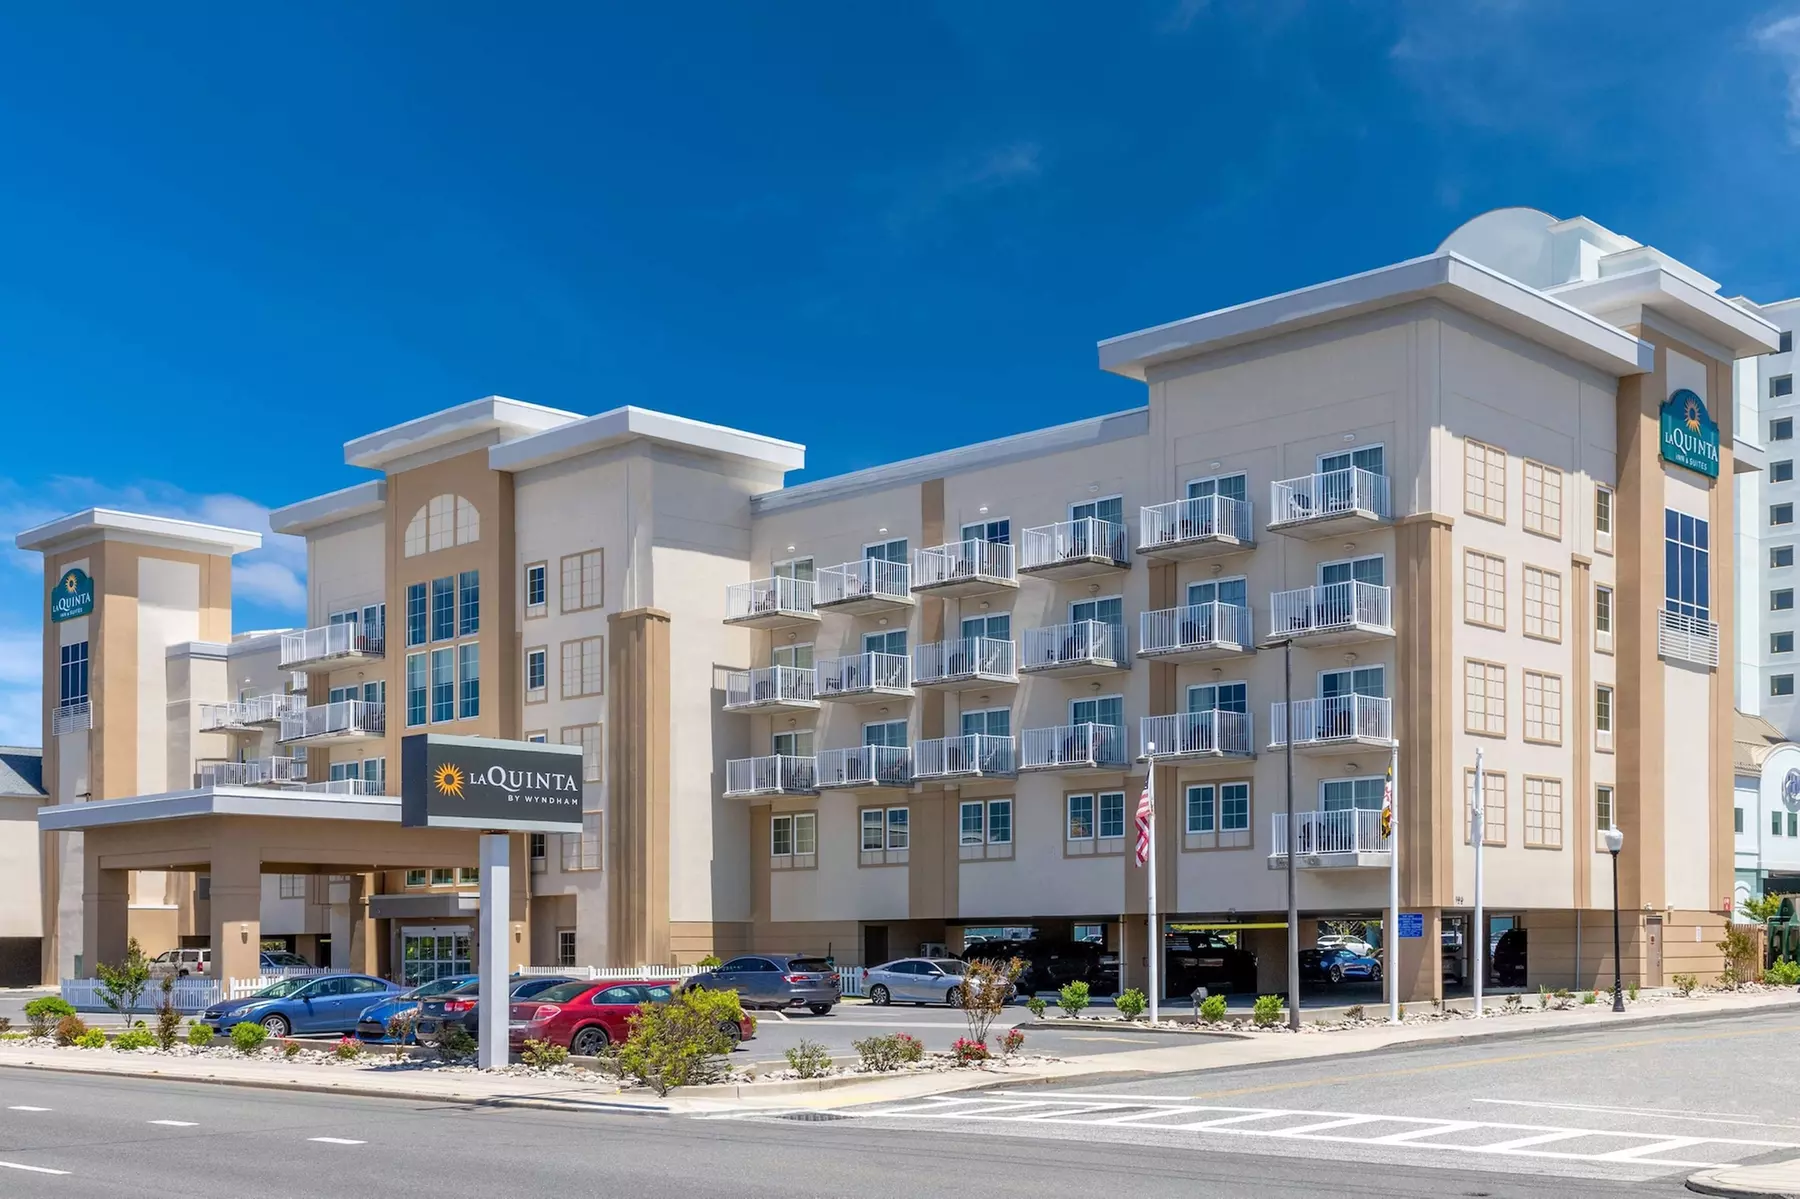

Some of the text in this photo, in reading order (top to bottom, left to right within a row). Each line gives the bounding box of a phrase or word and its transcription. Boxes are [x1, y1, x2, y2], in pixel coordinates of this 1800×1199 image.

[1673, 428, 1718, 462] QUINTA
[58, 592, 91, 611] QUINTA
[487, 766, 578, 792] QUINTA
[507, 794, 578, 806] BY WYNDHAM
